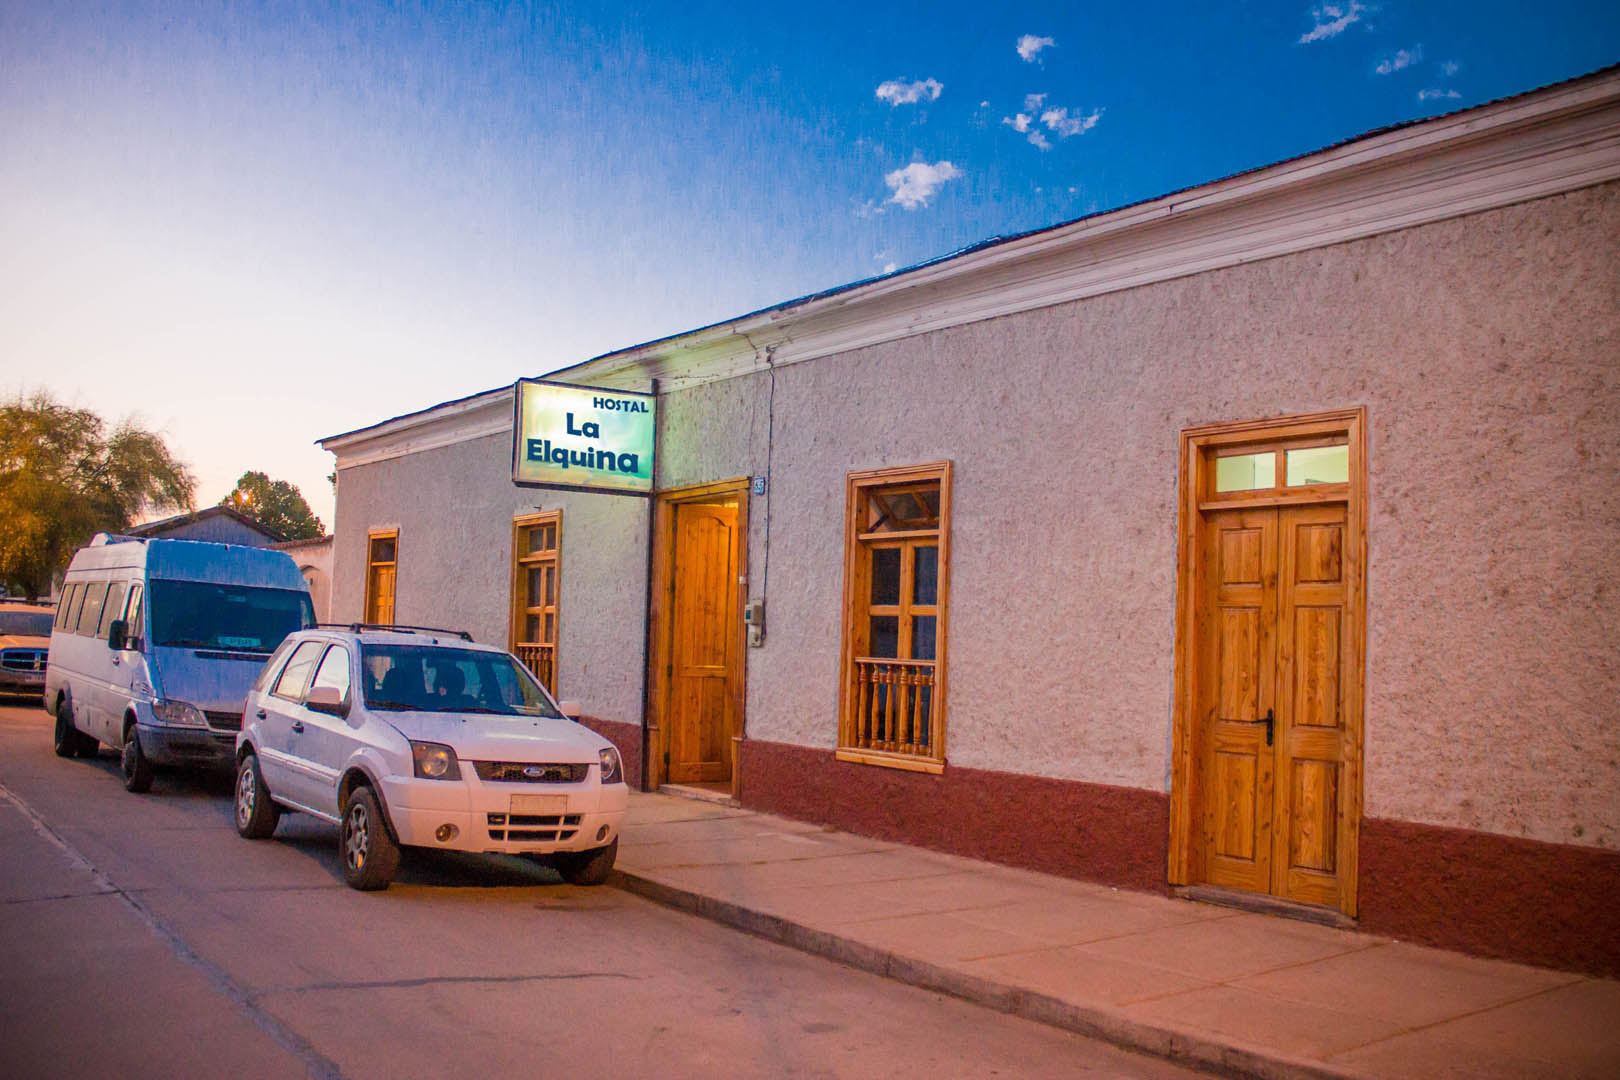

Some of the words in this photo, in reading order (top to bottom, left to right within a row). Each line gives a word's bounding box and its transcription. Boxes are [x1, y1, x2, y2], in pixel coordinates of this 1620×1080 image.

[593, 396, 649, 413] HOSTAL
[566, 412, 600, 439] La
[527, 438, 639, 473] Elquina
